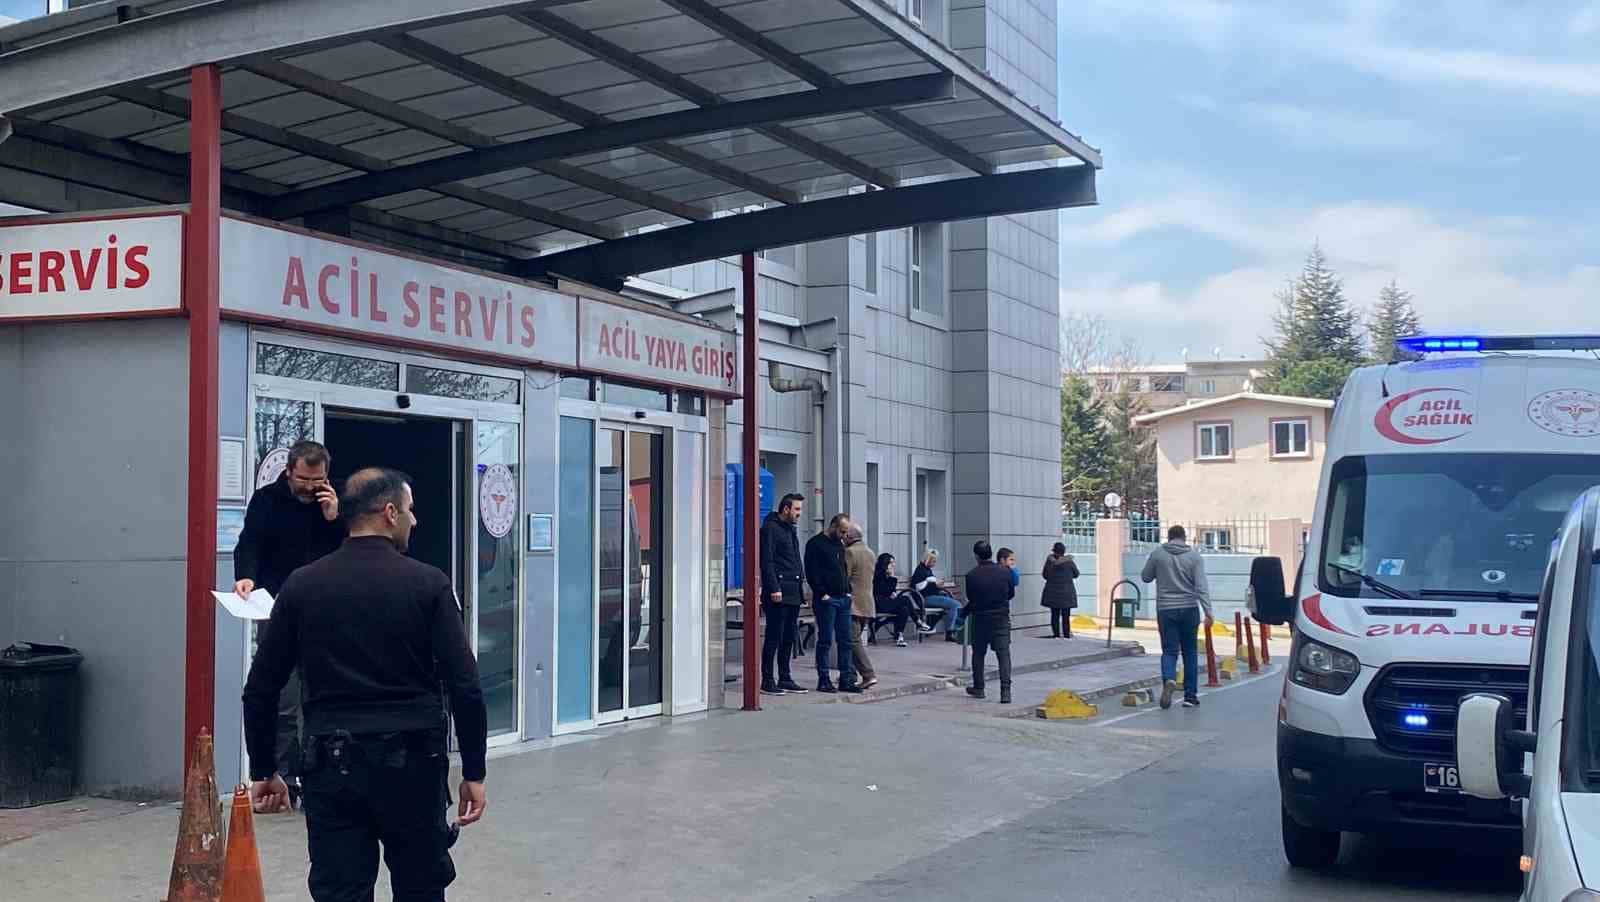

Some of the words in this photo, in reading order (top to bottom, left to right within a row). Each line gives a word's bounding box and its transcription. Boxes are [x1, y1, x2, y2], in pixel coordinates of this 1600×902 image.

[0, 233, 150, 295] ERVİS
[282, 256, 388, 323] ACİL
[402, 280, 536, 349] SERVİS
[598, 320, 641, 361] ACİL
[644, 335, 688, 372] YAYA
[691, 339, 734, 387] GİRİŞ
[1403, 411, 1473, 427] SAĞLIK
[1418, 397, 1462, 411] ACİL
[1438, 766, 1458, 787] 16
